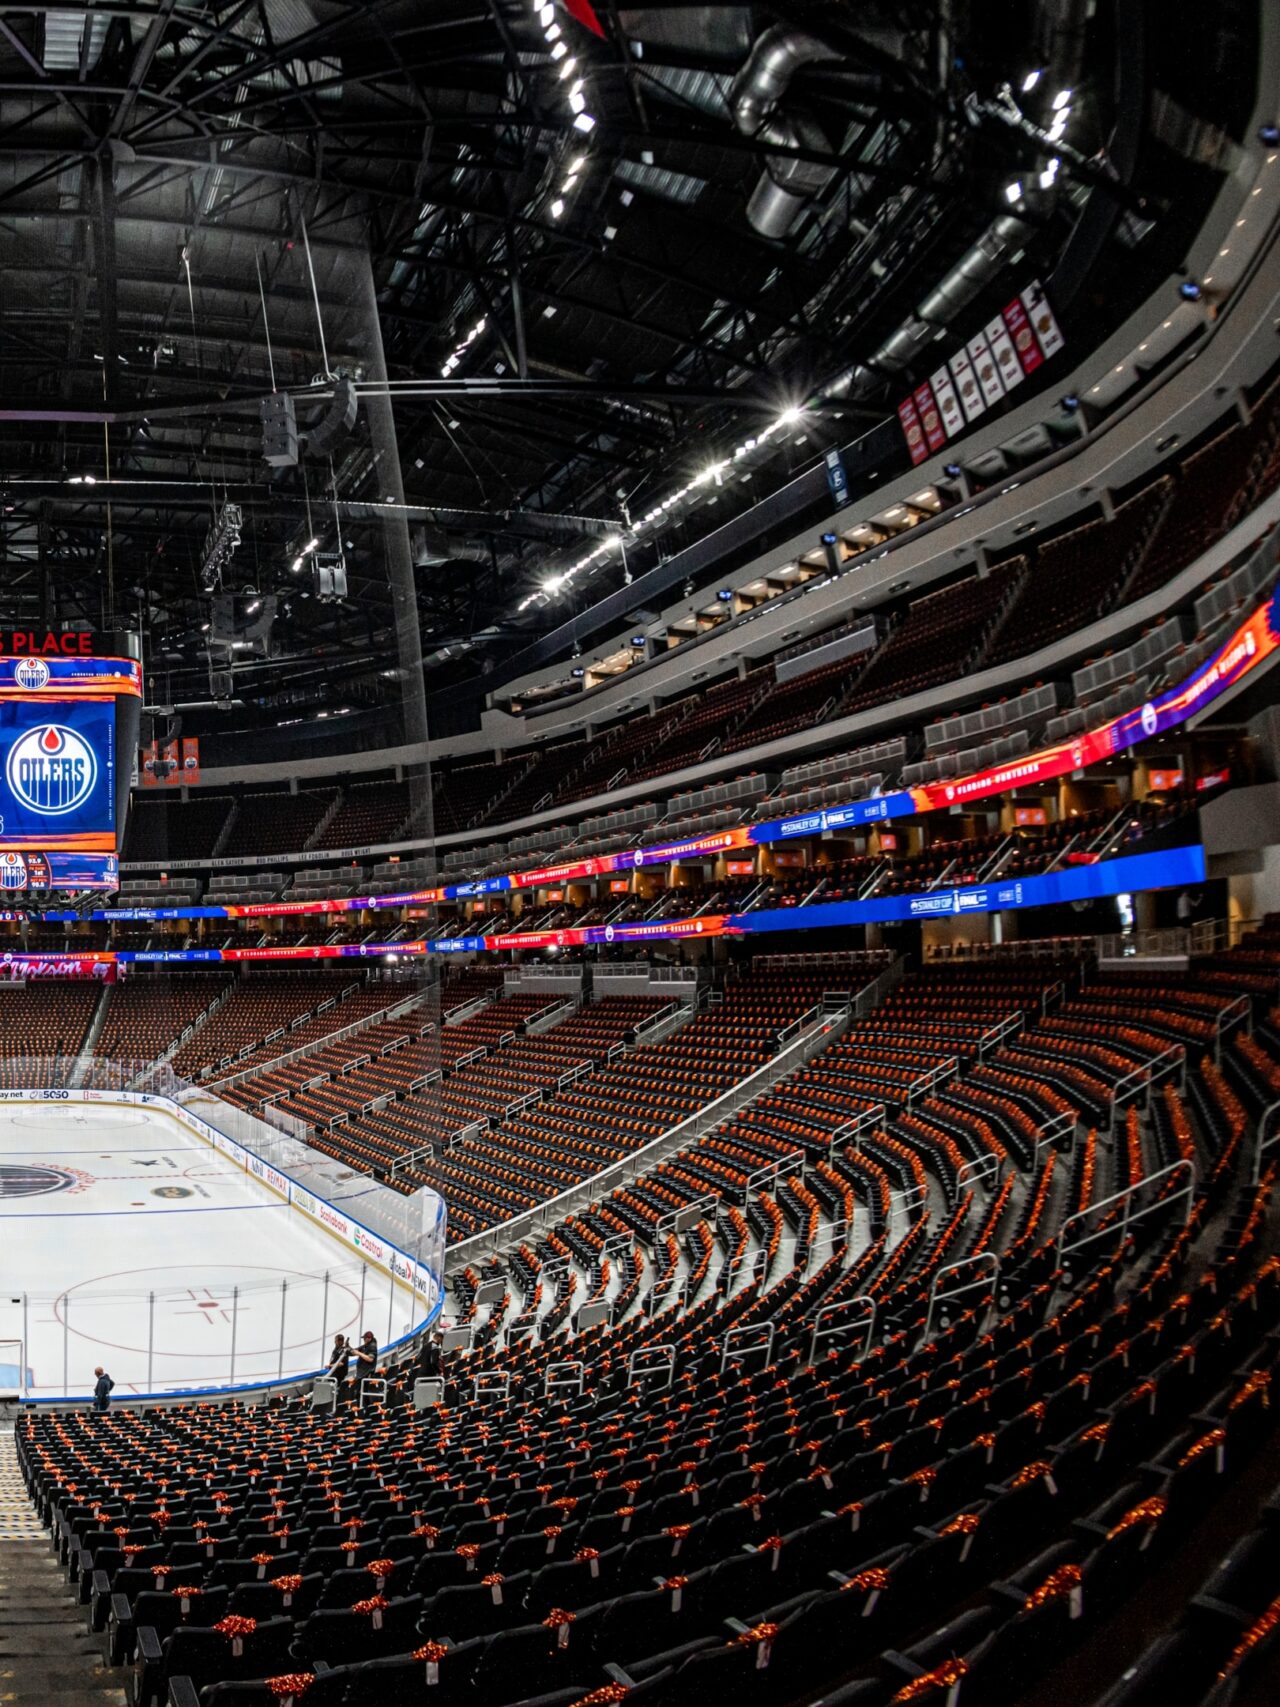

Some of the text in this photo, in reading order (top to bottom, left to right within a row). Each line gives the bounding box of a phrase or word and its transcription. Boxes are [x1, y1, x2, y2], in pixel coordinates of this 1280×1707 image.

[12, 632, 93, 653] PLACE
[19, 758, 84, 782] OILERS
[827, 813, 846, 824] FINAL
[959, 895, 979, 906] FINAL
[360, 1234, 383, 1258] Castrol
[411, 1273, 427, 1294] NEWS
